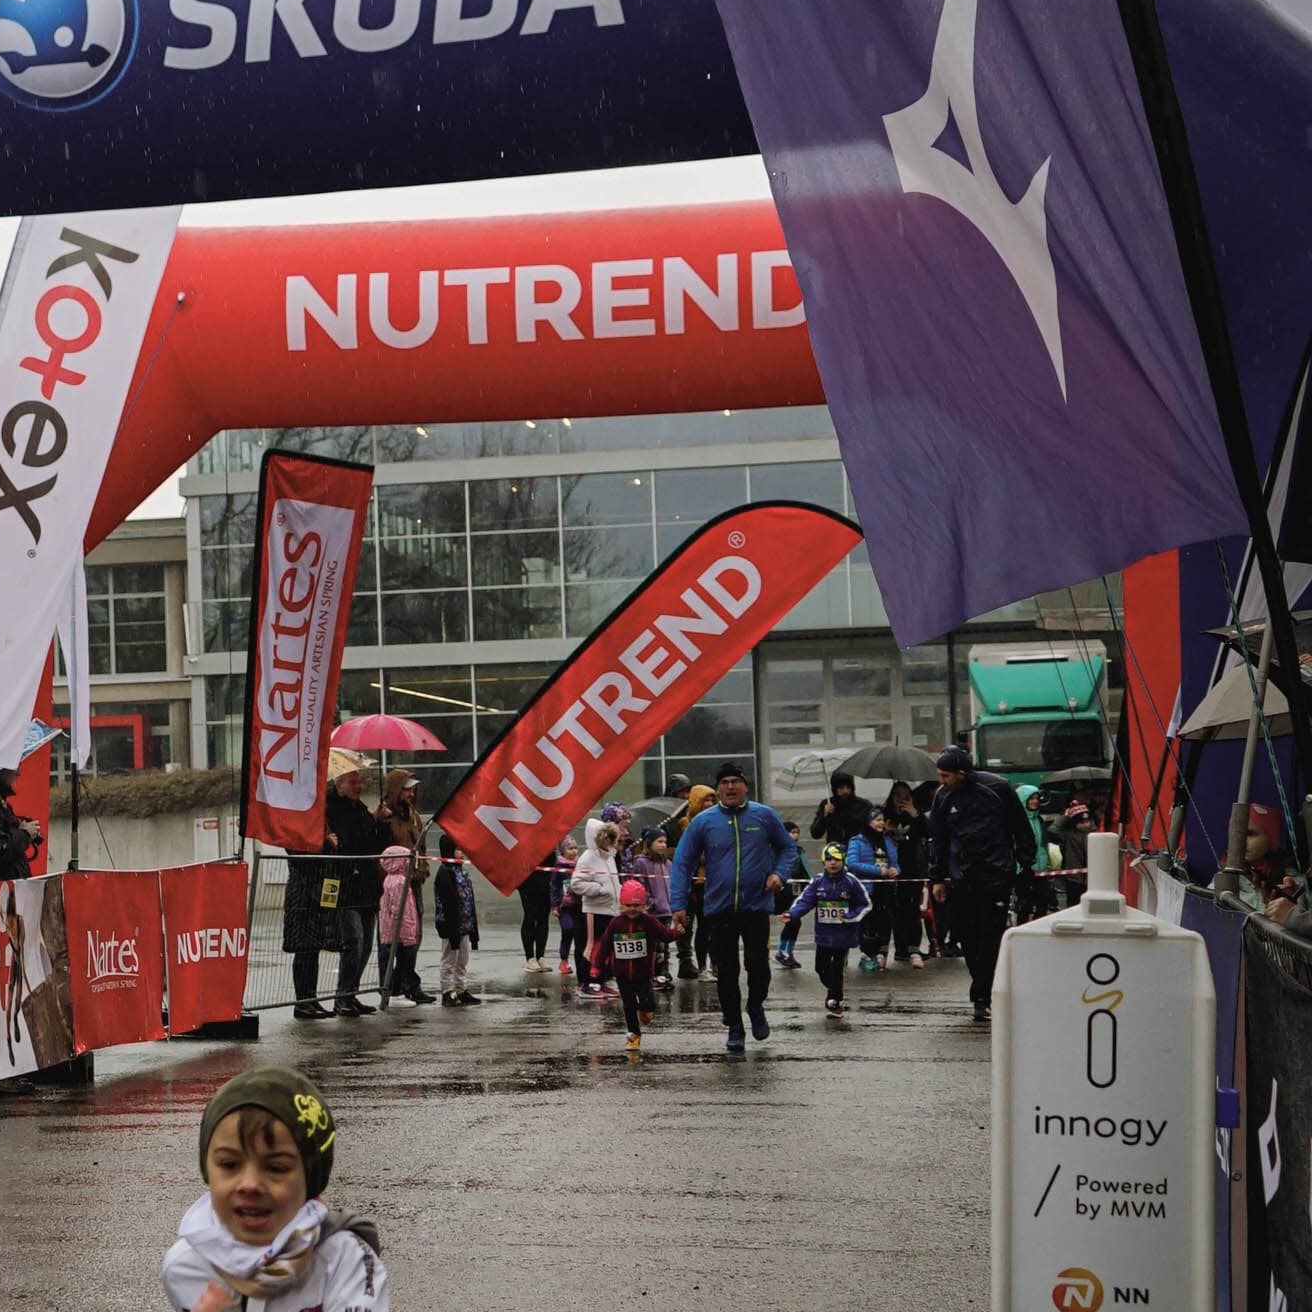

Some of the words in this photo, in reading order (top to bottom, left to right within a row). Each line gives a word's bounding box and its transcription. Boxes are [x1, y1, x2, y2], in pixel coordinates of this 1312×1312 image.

[287, 248, 808, 352] NUTREND
[323, 560, 339, 607] SPRING
[262, 531, 322, 785] Nartes
[311, 610, 328, 673] ARTESIAN
[305, 676, 320, 731] QUALITY
[474, 555, 763, 850] NUTREND
[303, 736, 313, 761] TOP
[87, 930, 139, 977] Nartes
[177, 928, 247, 965] NUTEND
[616, 941, 643, 953] 3138
[1035, 1106, 1168, 1146] innogy
[1076, 1174, 1168, 1196] Powered
[1076, 1198, 1100, 1221] by
[1111, 1200, 1166, 1219] MVM
[1113, 1287, 1150, 1304] NN
